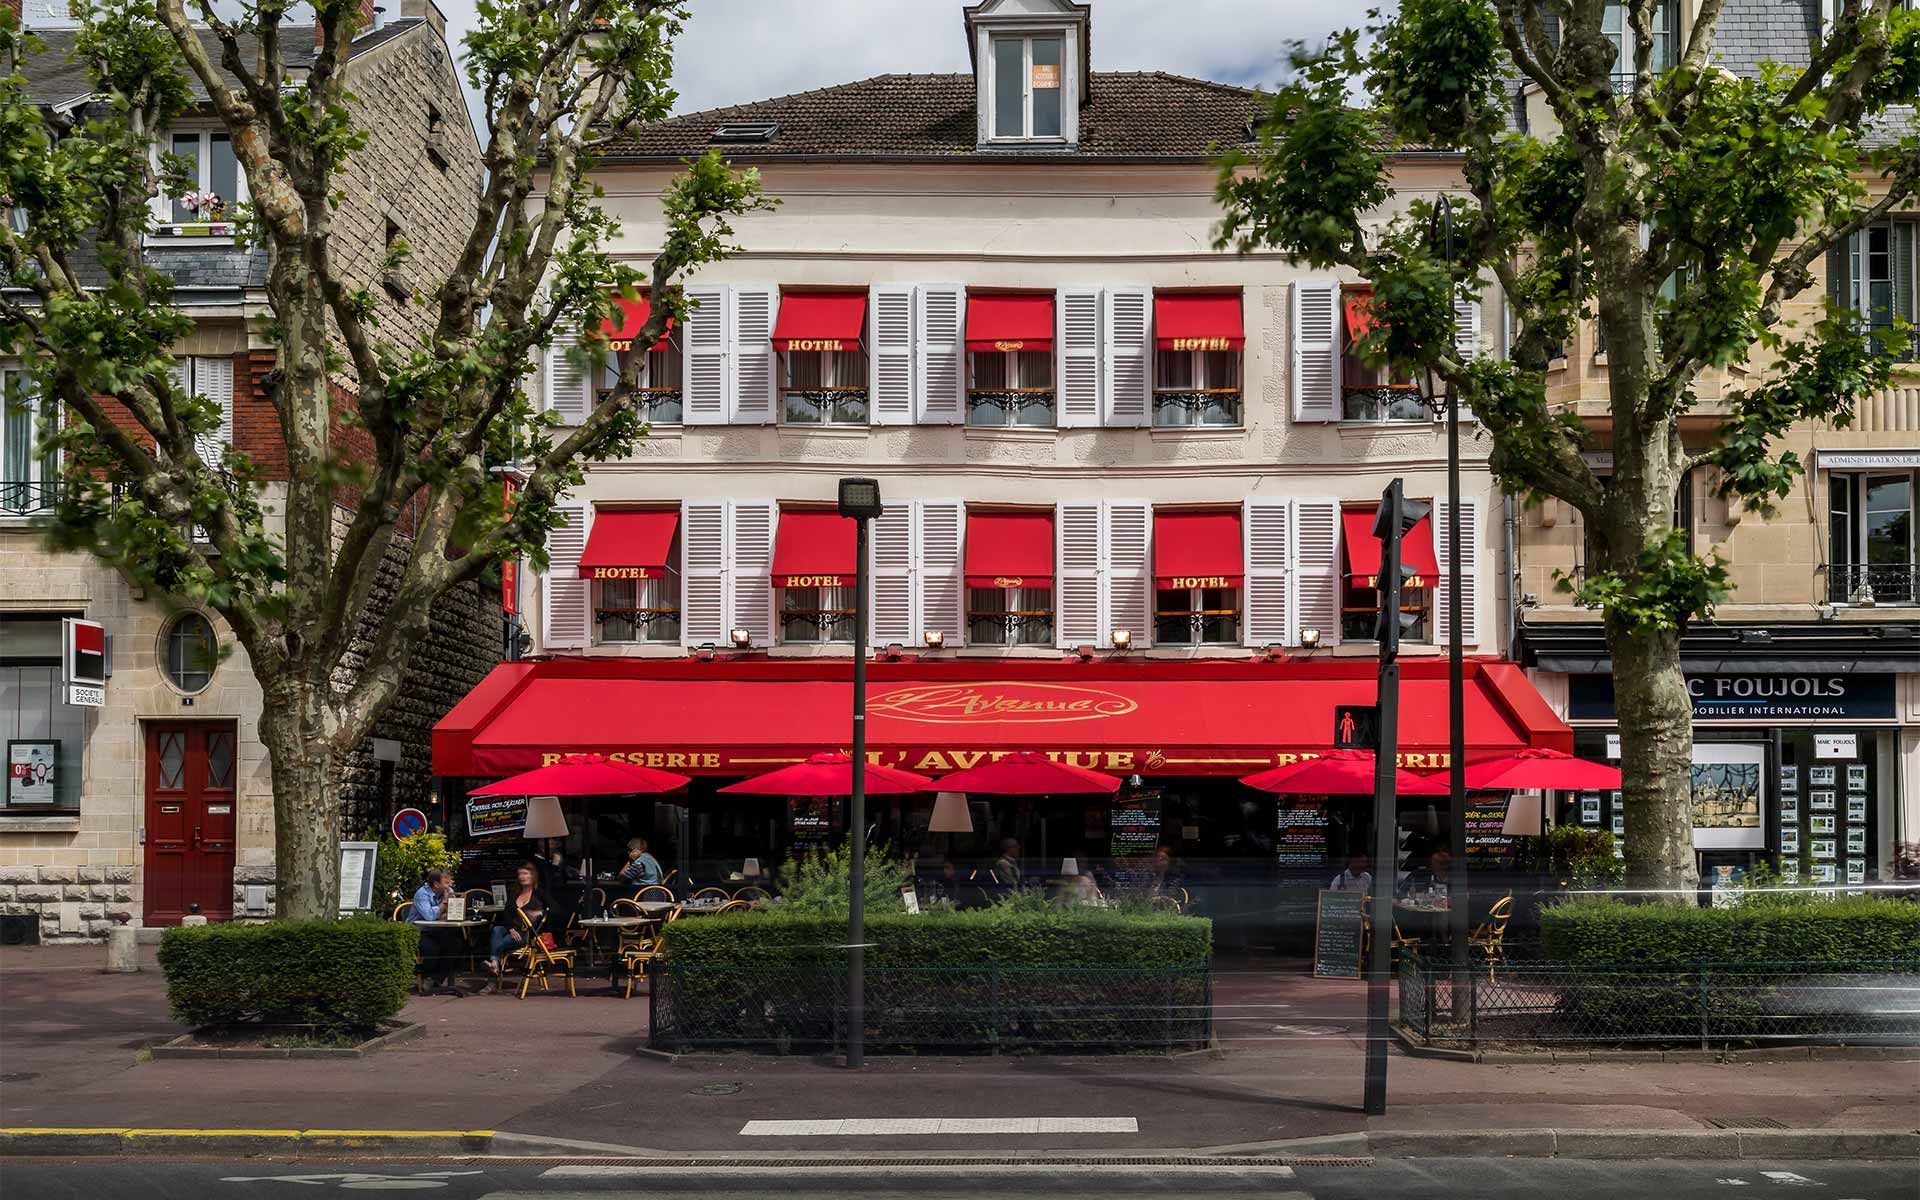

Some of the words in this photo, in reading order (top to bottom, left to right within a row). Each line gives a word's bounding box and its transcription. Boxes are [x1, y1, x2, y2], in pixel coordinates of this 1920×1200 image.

[788, 340, 843, 351] HOTEL
[1173, 338, 1230, 351] HOTEL
[1828, 456, 1899, 464] ADMINISTRATION
[594, 568, 649, 579] HOTEL
[786, 576, 842, 587] HOTEL
[1172, 577, 1229, 588] HOTEL
[1367, 575, 1424, 587] HEL
[1713, 678, 1845, 697] FOUJOLS
[872, 687, 1096, 715] L'Avenue
[1692, 706, 1744, 715] MOBILIER
[1750, 706, 1845, 715] INTERNATIONAL
[541, 753, 720, 767] BSSERIE
[865, 751, 1134, 769] L'AVUE
